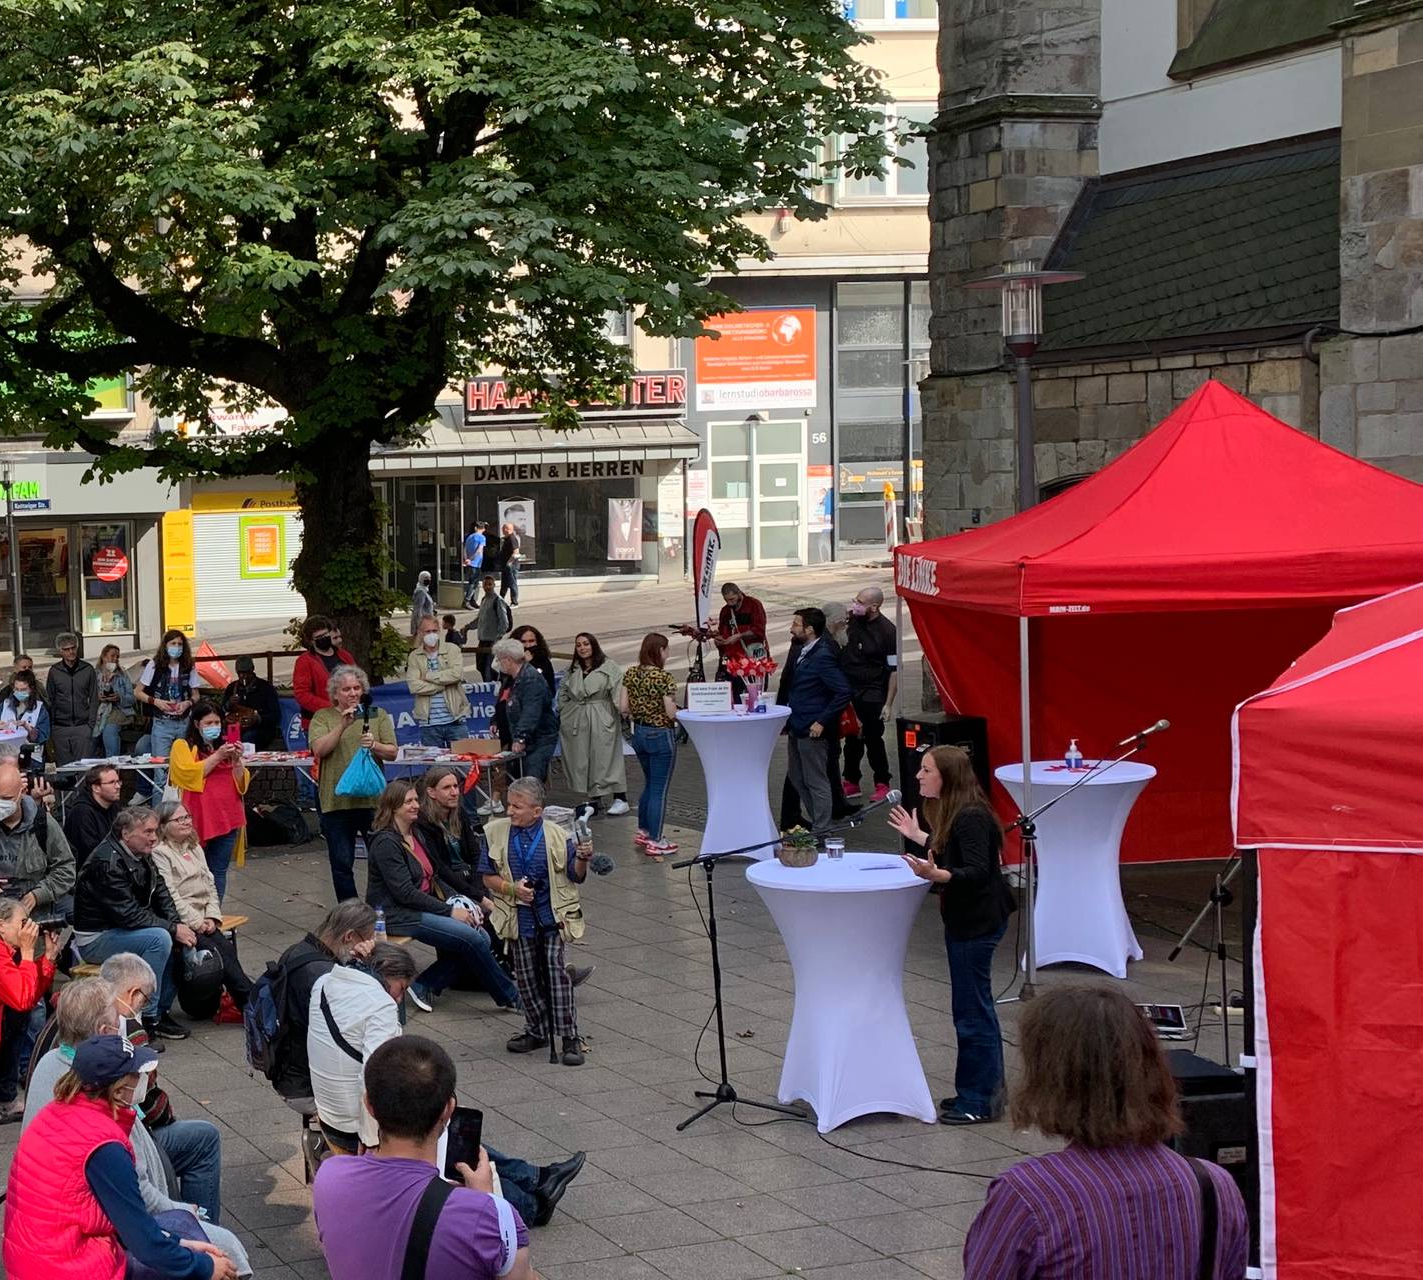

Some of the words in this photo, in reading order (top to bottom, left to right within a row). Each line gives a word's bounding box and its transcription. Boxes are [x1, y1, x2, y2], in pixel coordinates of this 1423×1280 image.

[467, 380, 553, 412] HAA
[812, 432, 827, 445] 56
[474, 464, 542, 482] DAMEN
[548, 465, 560, 478] &
[566, 460, 645, 478] HERREN
